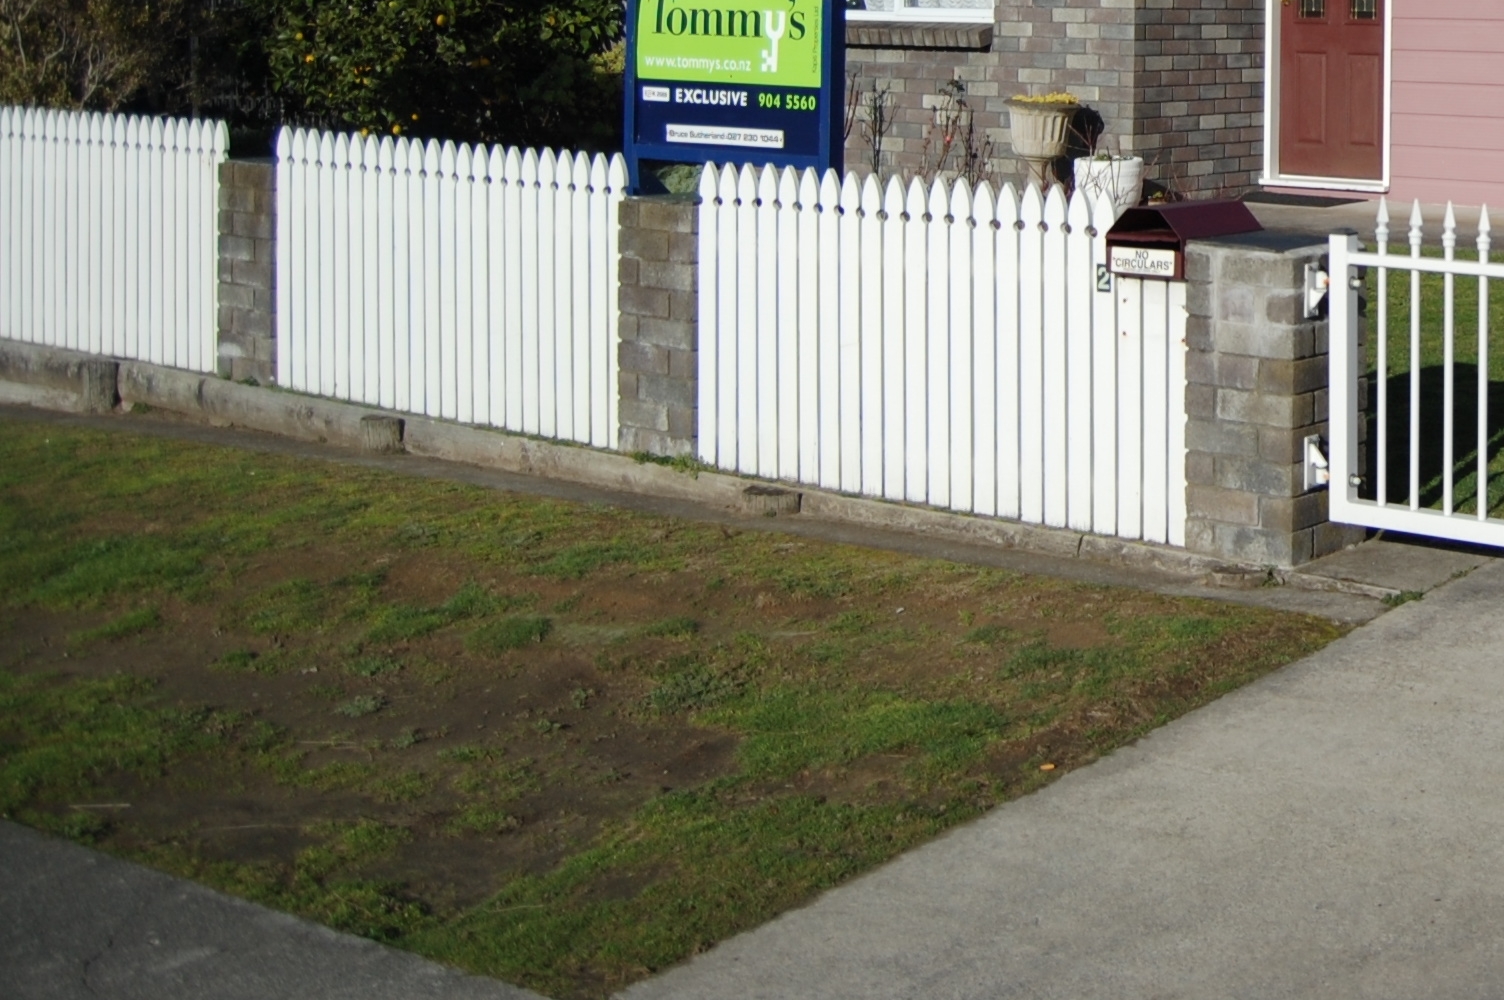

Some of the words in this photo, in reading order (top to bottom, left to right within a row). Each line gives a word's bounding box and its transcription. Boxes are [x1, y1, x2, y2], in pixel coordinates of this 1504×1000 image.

[645, 55, 752, 73] www.tommys.co.nz
[675, 87, 748, 107] EXCLUSIVE
[758, 92, 781, 108] 904
[785, 94, 816, 110] 5560
[1135, 250, 1149, 260] NO
[1098, 266, 1110, 290] 2
